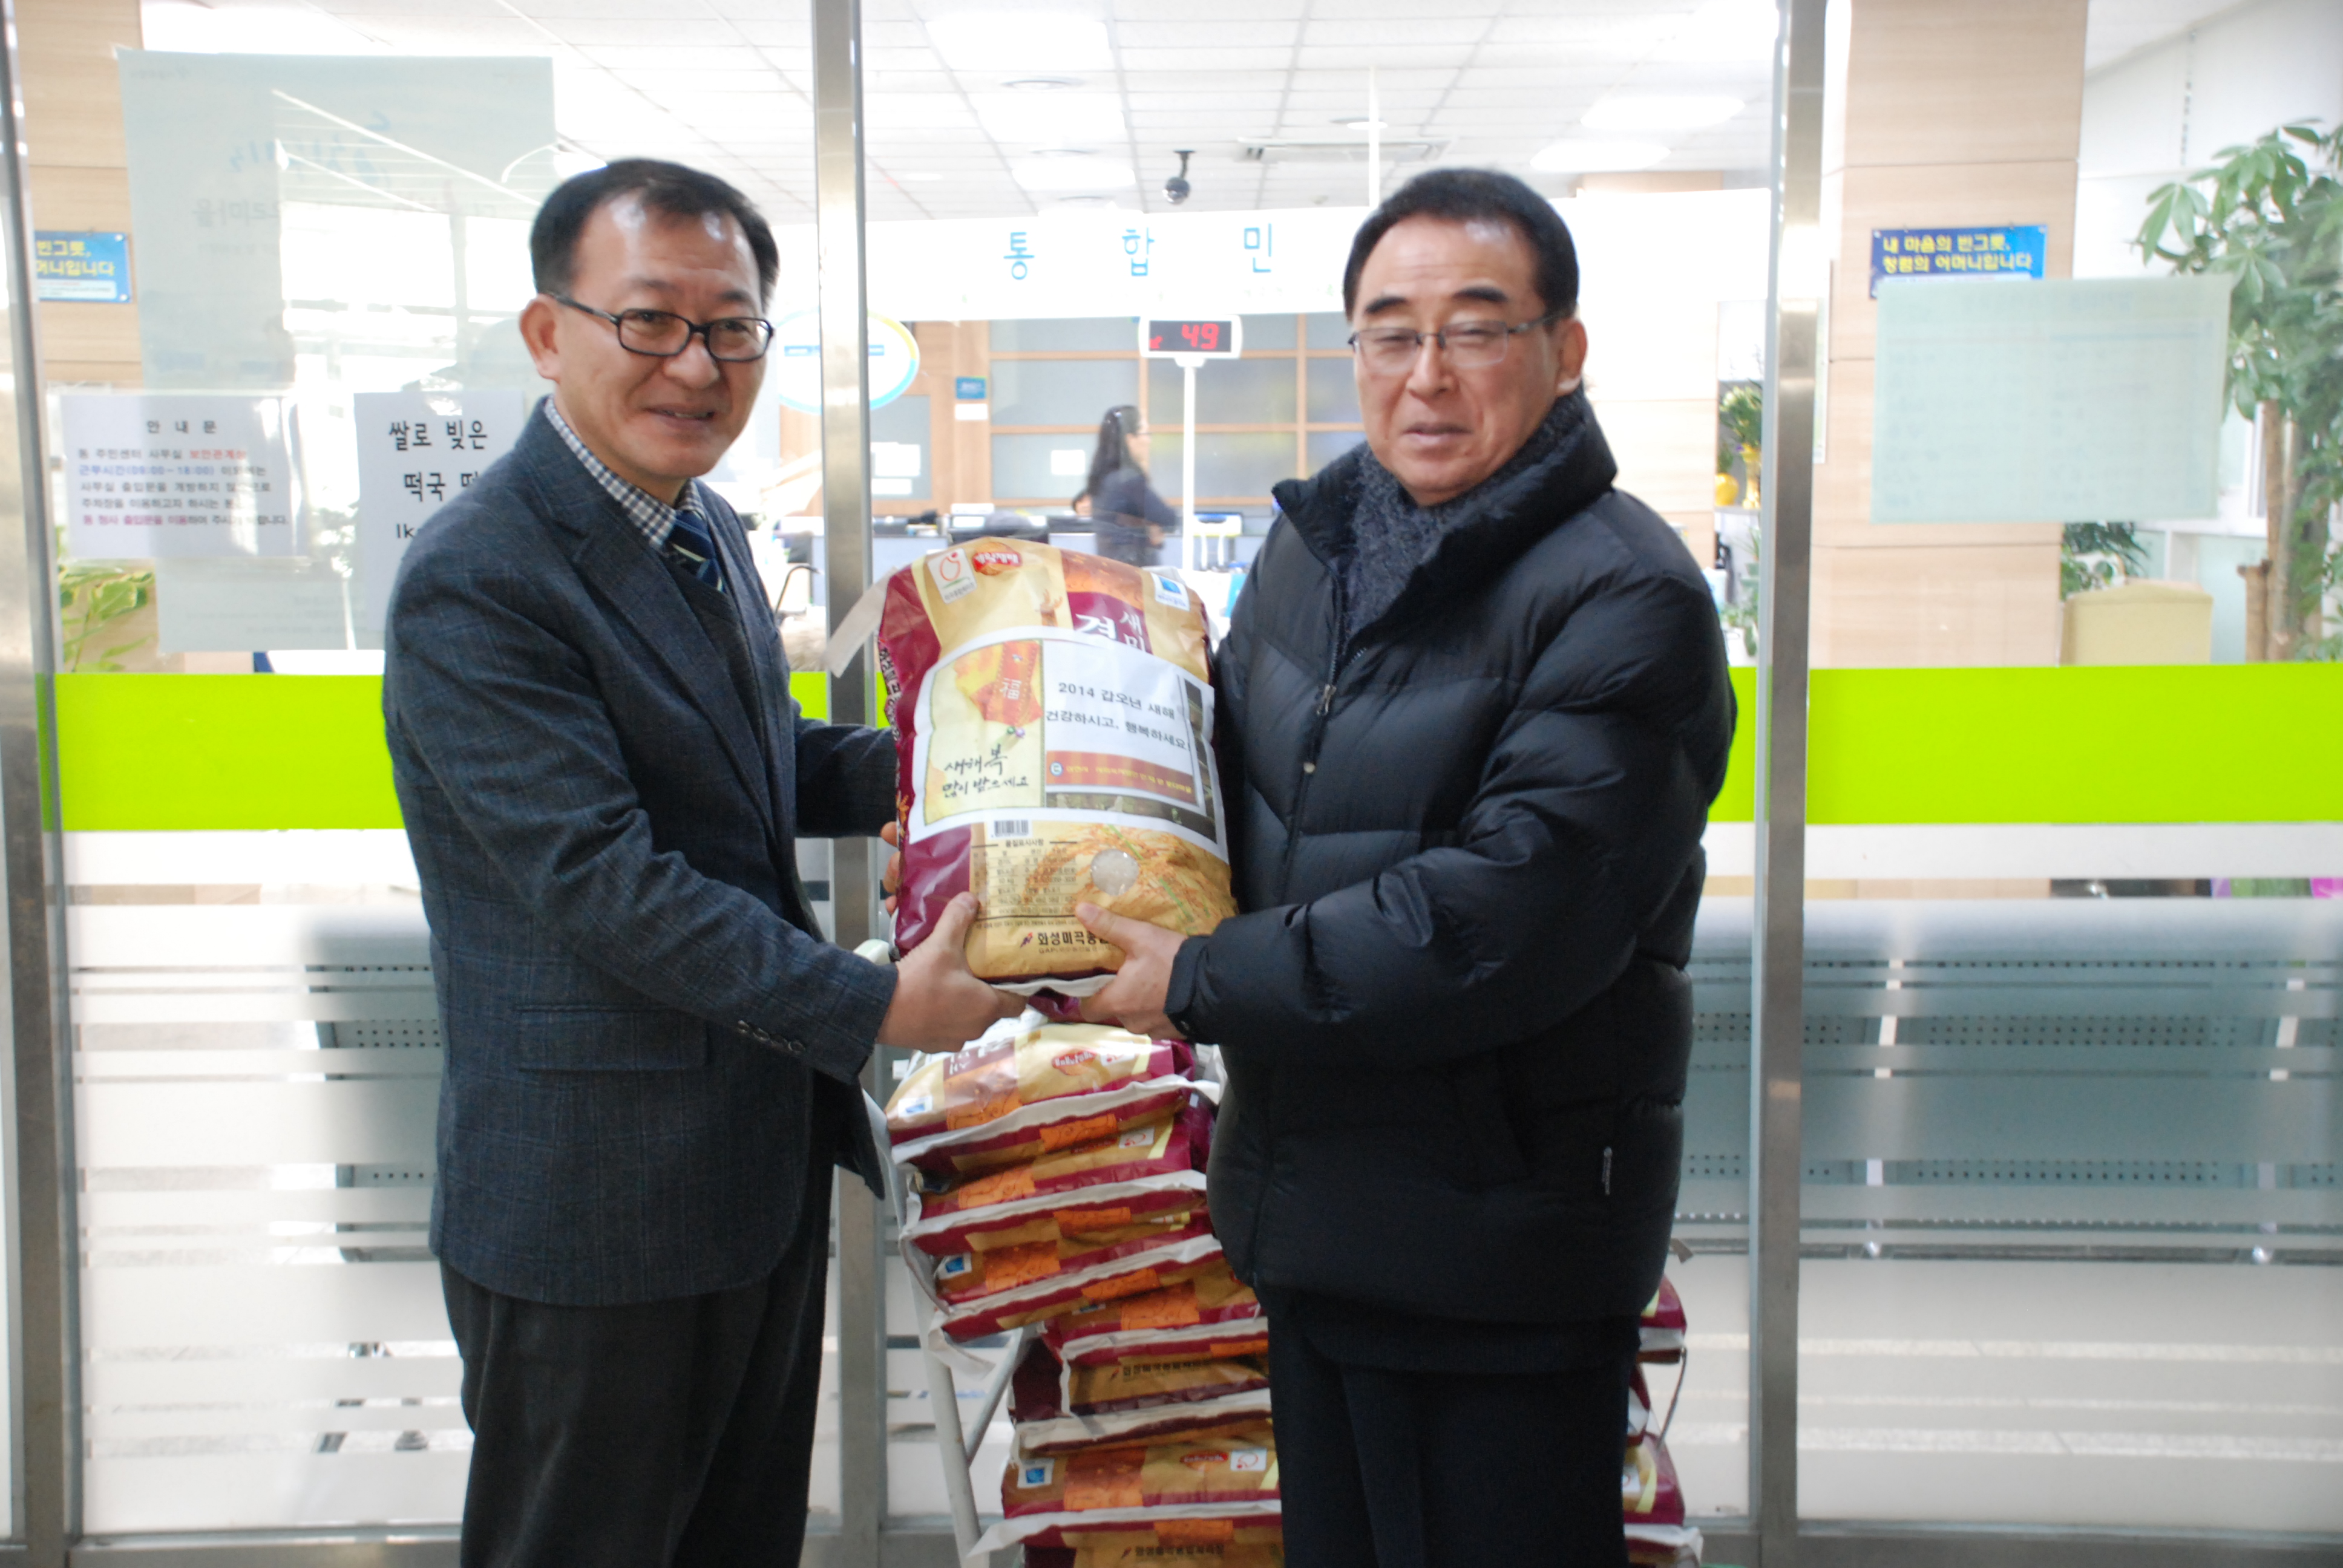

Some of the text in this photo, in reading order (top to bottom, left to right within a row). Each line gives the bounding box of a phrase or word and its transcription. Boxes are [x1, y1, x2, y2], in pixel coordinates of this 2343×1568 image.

[1003, 223, 1272, 280] 통 합 민
[1883, 237, 1899, 254] 내
[1935, 251, 2033, 272] 어머니입니다
[1181, 322, 1219, 350] 49
[146, 420, 217, 434] 안 내 문
[389, 420, 487, 451] 쌀로 빚은
[404, 471, 446, 502] 떡국
[1000, 677, 1022, 701] 福
[1059, 682, 1175, 720] 2014 갑오년 새해
[1046, 710, 1119, 730] 건강하시고,
[945, 743, 1008, 776] 새해 복
[942, 776, 1029, 799] 많이 받으세요
